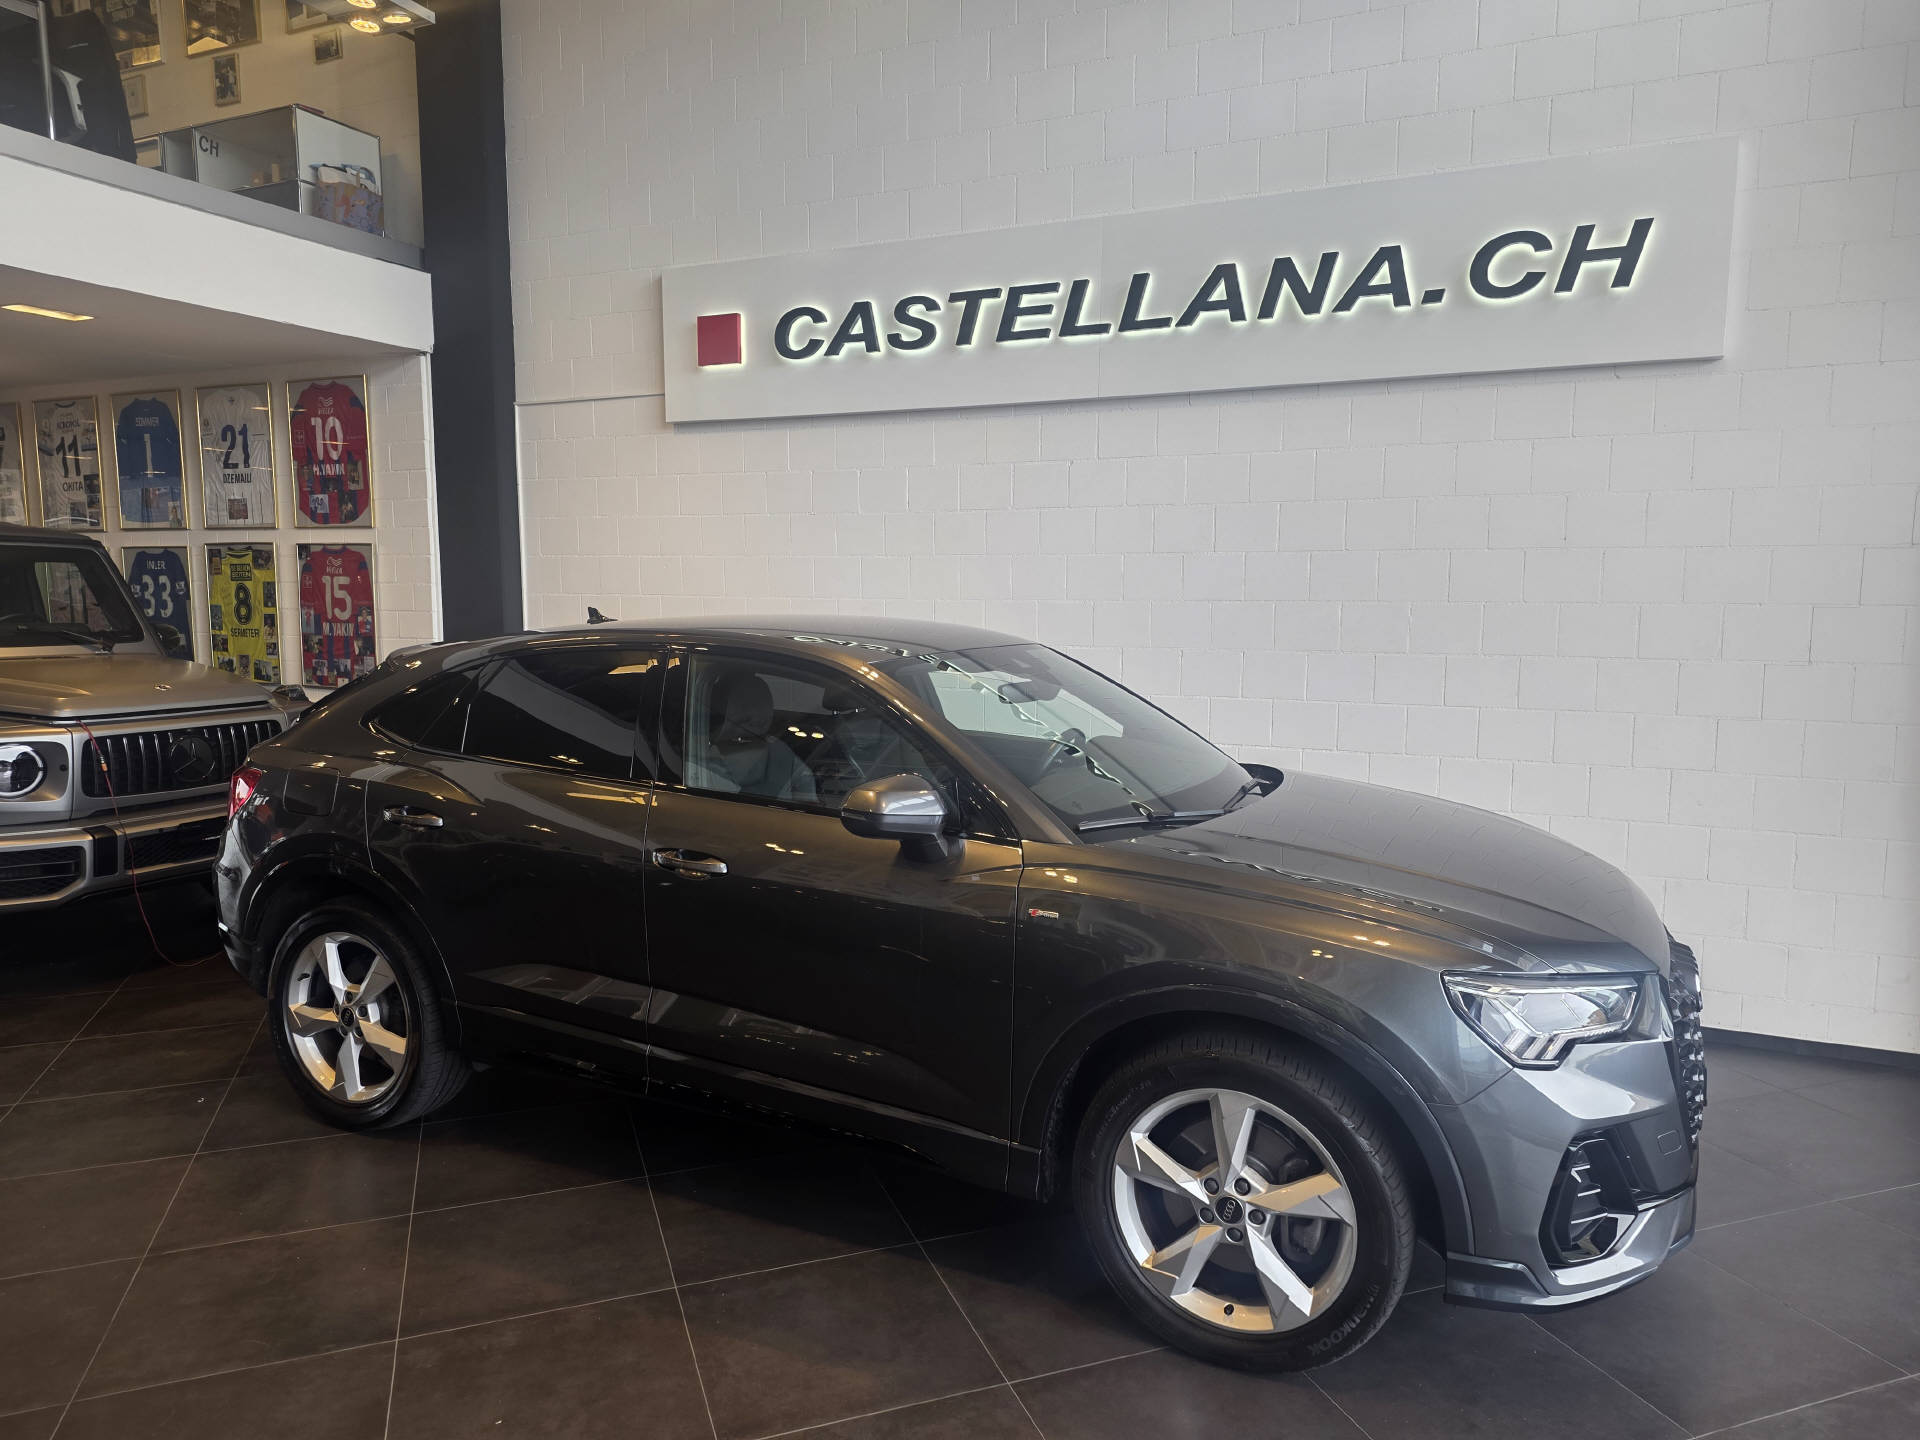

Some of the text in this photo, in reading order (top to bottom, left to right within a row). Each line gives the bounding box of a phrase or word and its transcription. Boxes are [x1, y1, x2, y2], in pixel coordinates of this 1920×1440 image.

[199, 135, 219, 157] CH
[774, 217, 1655, 360] CASTELLANA.CH
[55, 435, 81, 478] 11
[143, 433, 153, 477] 1
[221, 424, 250, 469] 21
[311, 416, 344, 461] 10
[62, 481, 84, 492] OKITA
[141, 574, 174, 618] 33
[234, 582, 253, 626] 8
[321, 575, 353, 621] 15
